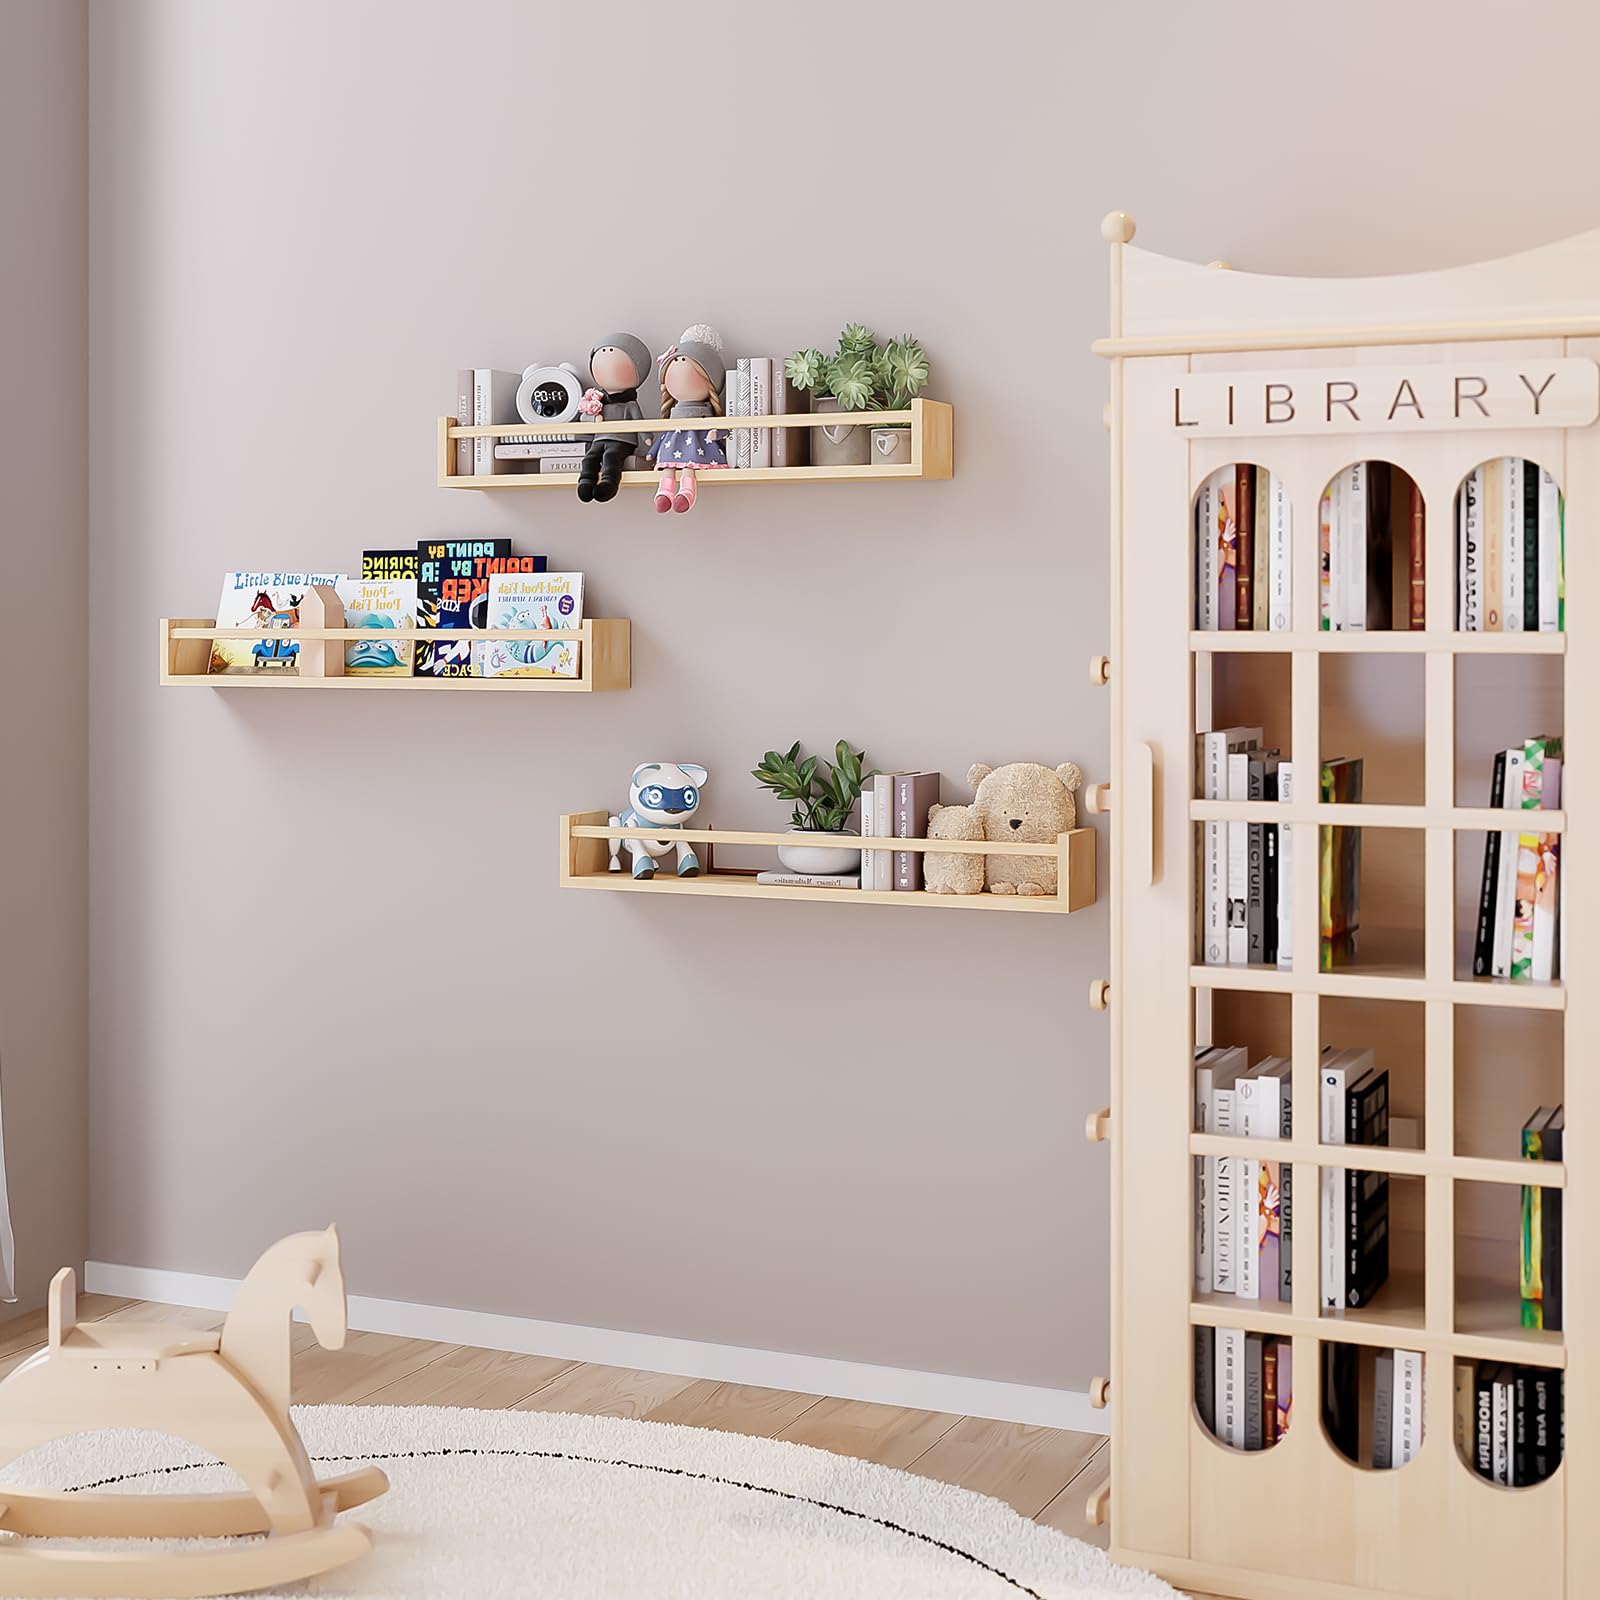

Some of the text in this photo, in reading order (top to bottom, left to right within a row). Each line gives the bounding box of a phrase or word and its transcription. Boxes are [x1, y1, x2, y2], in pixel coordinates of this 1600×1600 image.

[1173, 373, 1557, 427] LIBRARY
[233, 572, 270, 590] Little
[272, 572, 301, 587] Blue
[1283, 773, 1292, 798] Ron
[1250, 774, 1260, 908] ARITECTURE
[1283, 1098, 1292, 1241] ARCECTURE
[1218, 1231, 1230, 1286] BOOK
